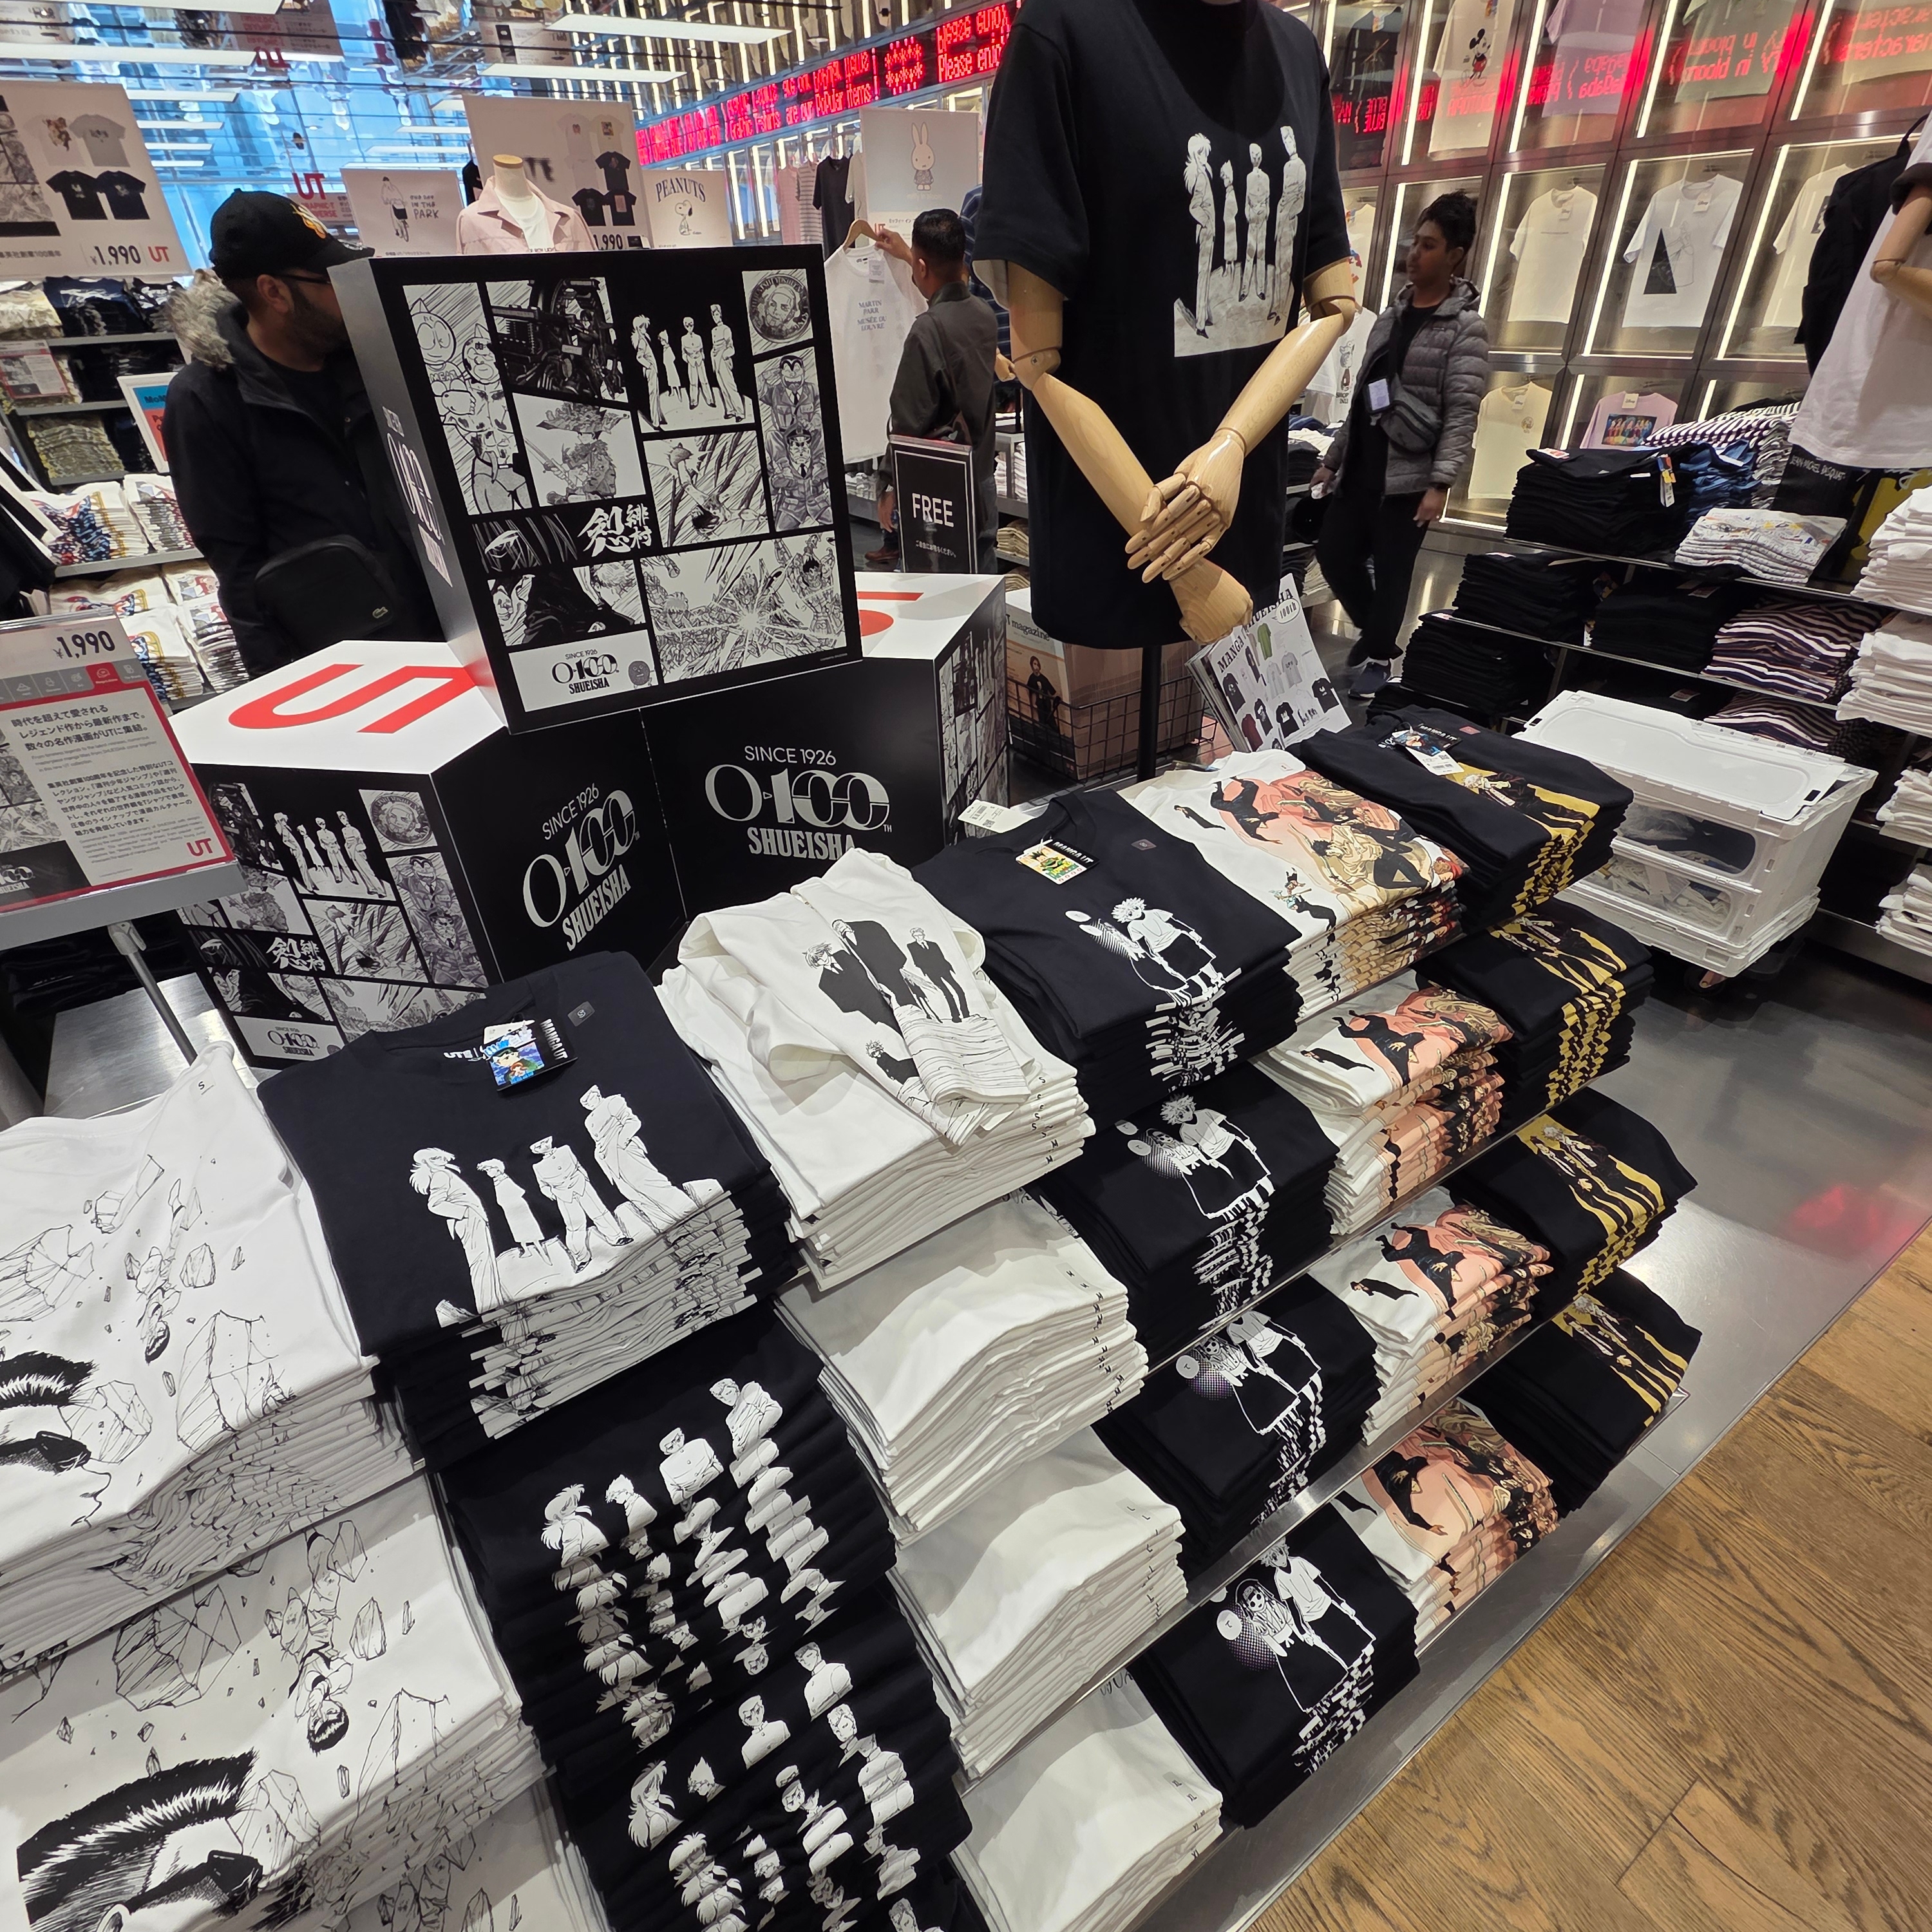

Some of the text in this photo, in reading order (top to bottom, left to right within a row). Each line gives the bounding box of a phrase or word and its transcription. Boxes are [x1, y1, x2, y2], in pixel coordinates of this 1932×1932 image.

[938, 52, 972, 82] Please
[785, 106, 800, 125] are
[292, 173, 325, 200] UT
[656, 177, 706, 203] PEANUTS
[413, 209, 439, 219] PARK
[147, 246, 170, 263] UT
[858, 299, 882, 308] MARTIN
[857, 316, 878, 325] MUSÉE
[860, 323, 885, 332] LOUVRE
[912, 493, 954, 527] FREE
[1011, 620, 1050, 641] magazine
[53, 630, 115, 659] ¥1,990
[565, 651, 584, 660] SINCE
[569, 677, 610, 695] SHUEISHA
[11, 705, 109, 728] 時代を超えて愛される
[19, 712, 146, 739] レジェンド作から最新作まで。
[24, 724, 148, 752] 数々の名作漫画がUTに集結。
[744, 745, 837, 766] SINCE 1926
[542, 782, 600, 840] SINCE 1926
[187, 837, 213, 857] UT
[1053, 841, 1082, 858] MANGA
[562, 864, 631, 951] SHUEISHA
[577, 1009, 586, 1018] S
[540, 1018, 569, 1060] MANGA UT
[198, 1081, 205, 1090] S
[1051, 1139, 1058, 1148] M
[1186, 1793, 1197, 1802] XL
